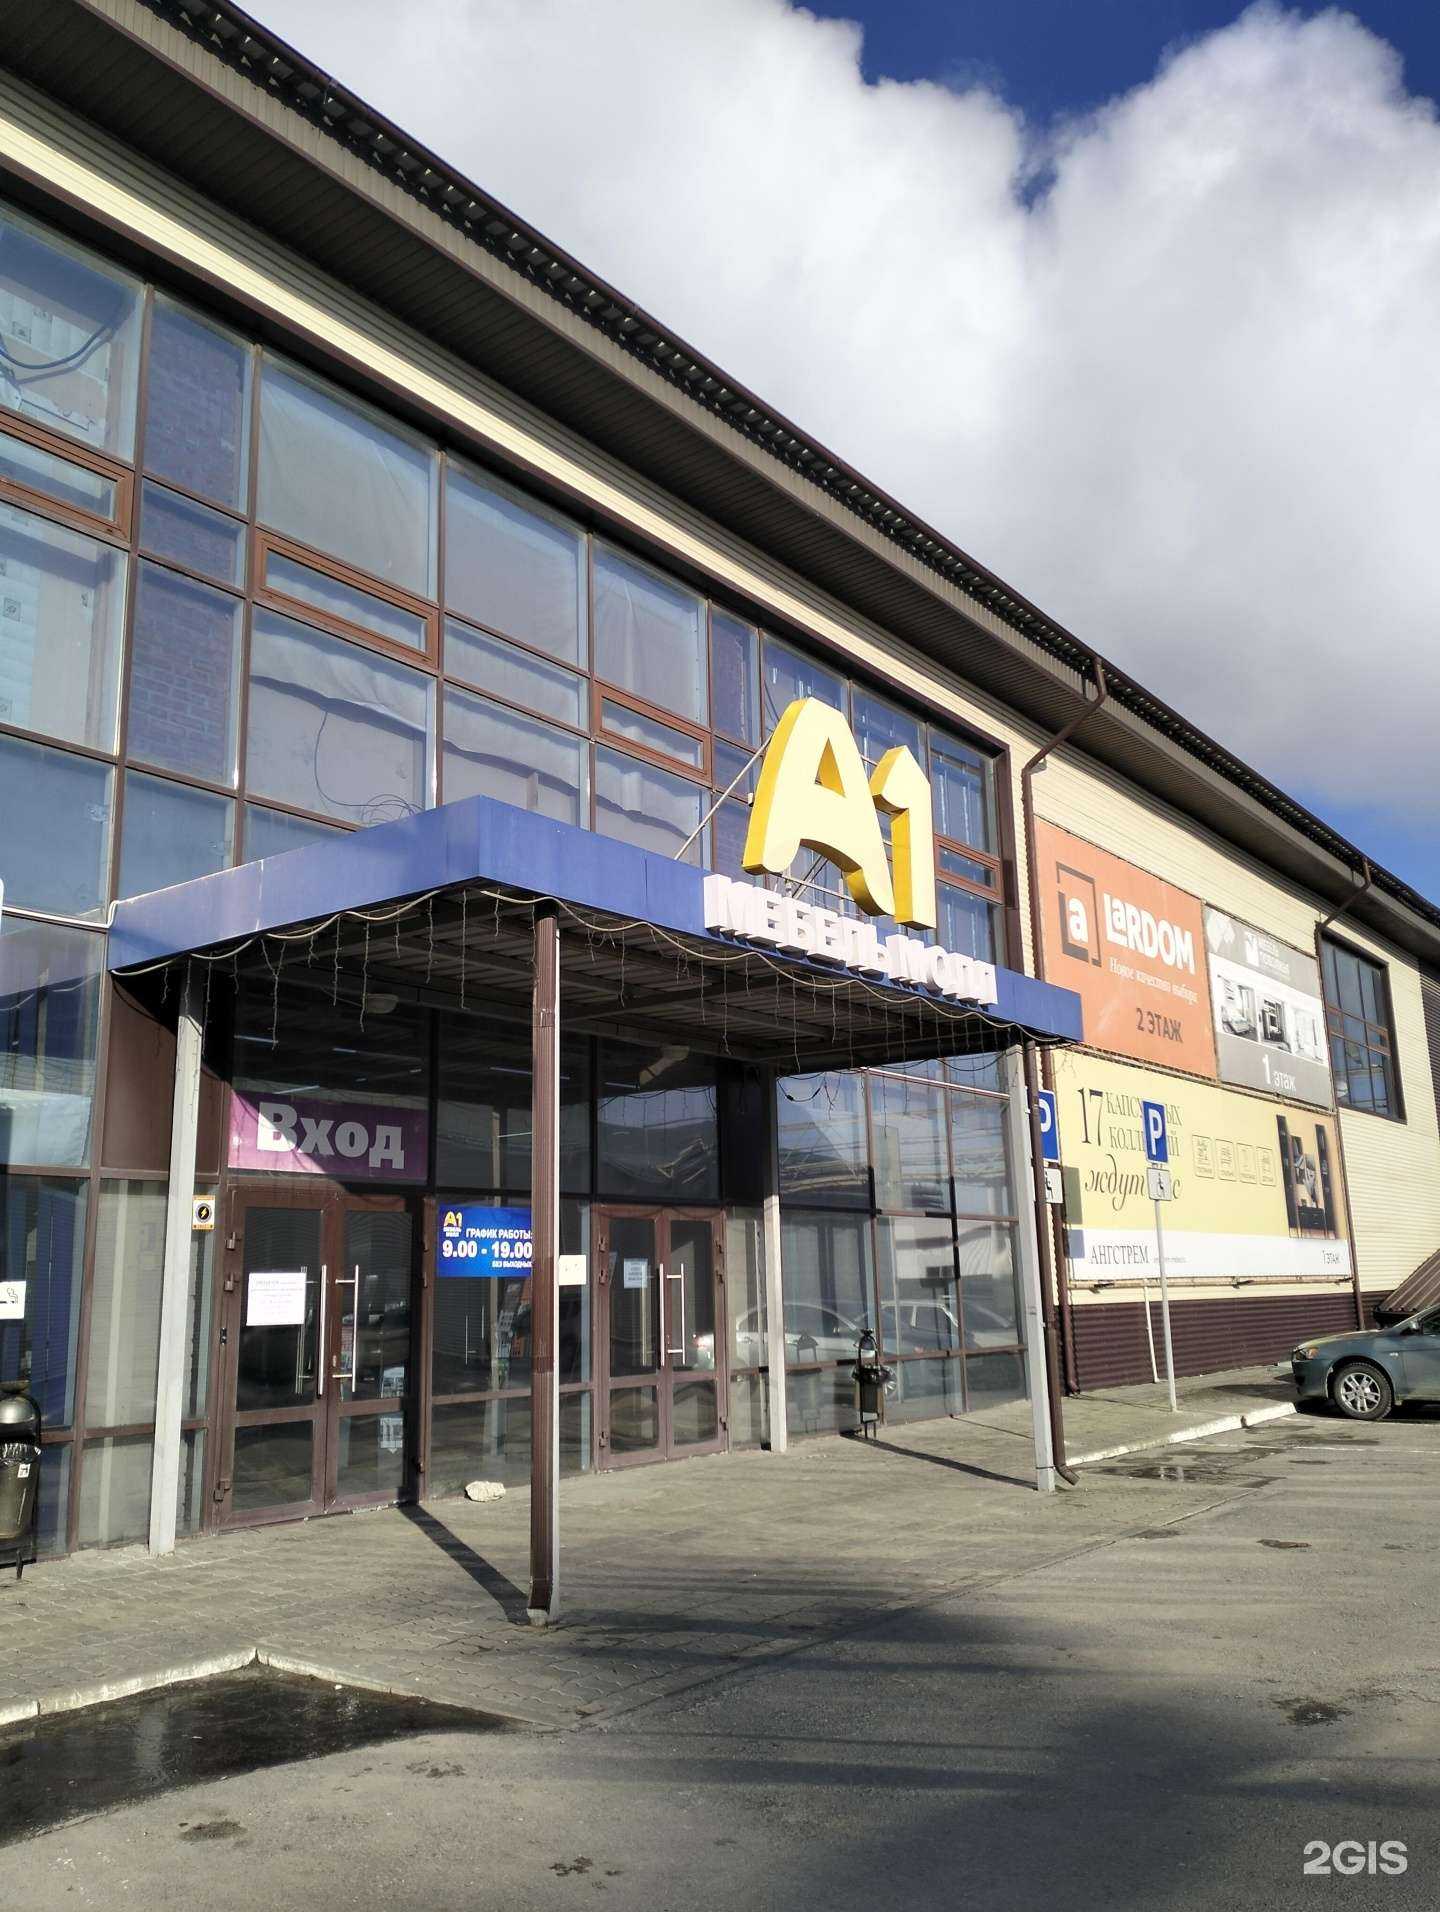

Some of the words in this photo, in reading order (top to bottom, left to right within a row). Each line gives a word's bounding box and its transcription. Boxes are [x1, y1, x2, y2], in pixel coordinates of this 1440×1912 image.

[743, 697, 936, 929] А1
[1136, 1007, 1145, 1032] 2
[1147, 1011, 1184, 1043] ЭТАЖ
[1262, 1054, 1271, 1085] 1
[1077, 1087, 1104, 1147] 17
[1105, 1091, 1183, 1127] КАПСУЫХ
[257, 1101, 405, 1170] Вход
[1148, 1108, 1163, 1156] P
[442, 1240, 478, 1258] 9.00
[491, 1241, 533, 1259] 19.00
[466, 1228, 498, 1240] ГРАФИК
[498, 1229, 533, 1240] РАБОТЫ:
[1090, 1244, 1150, 1265] АНГСТРЕМ
